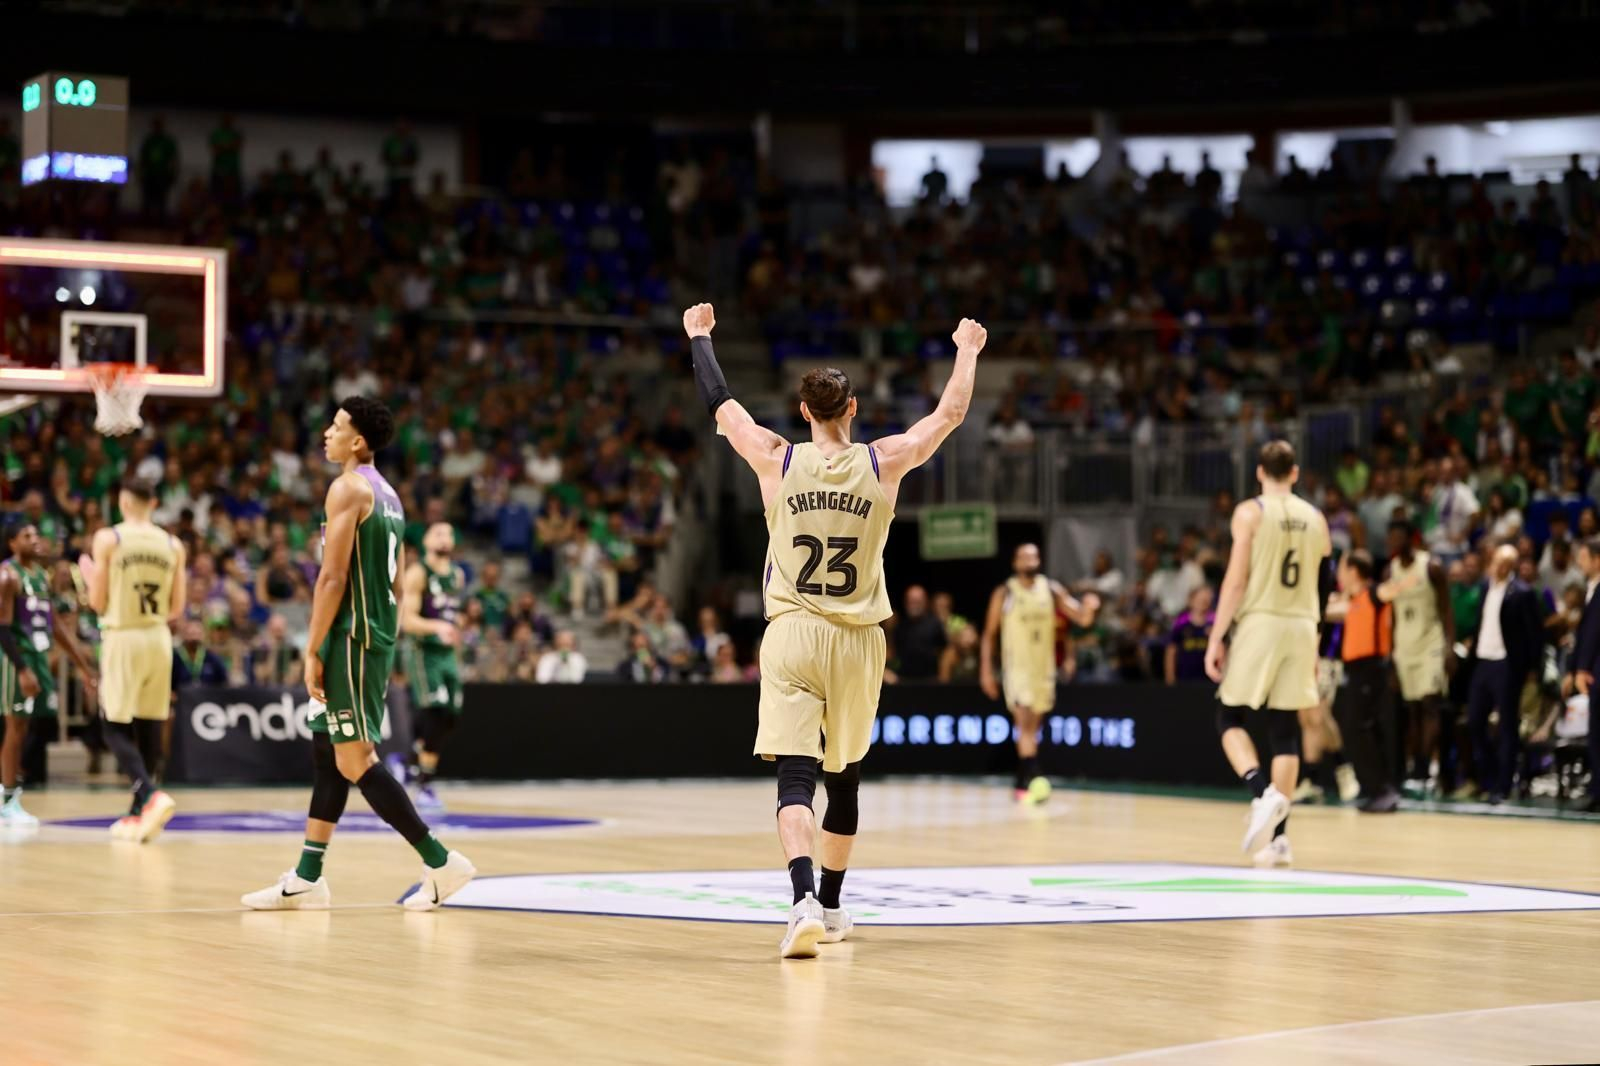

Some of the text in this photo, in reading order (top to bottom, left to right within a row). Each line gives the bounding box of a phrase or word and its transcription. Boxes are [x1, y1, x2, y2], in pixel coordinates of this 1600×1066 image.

[55, 78, 96, 107] 0.0
[787, 491, 872, 519] SHENGELIA
[793, 534, 858, 597] 23
[1280, 549, 1300, 589] 6
[1050, 715, 1082, 746] TO
[1088, 716, 1136, 748] THE
